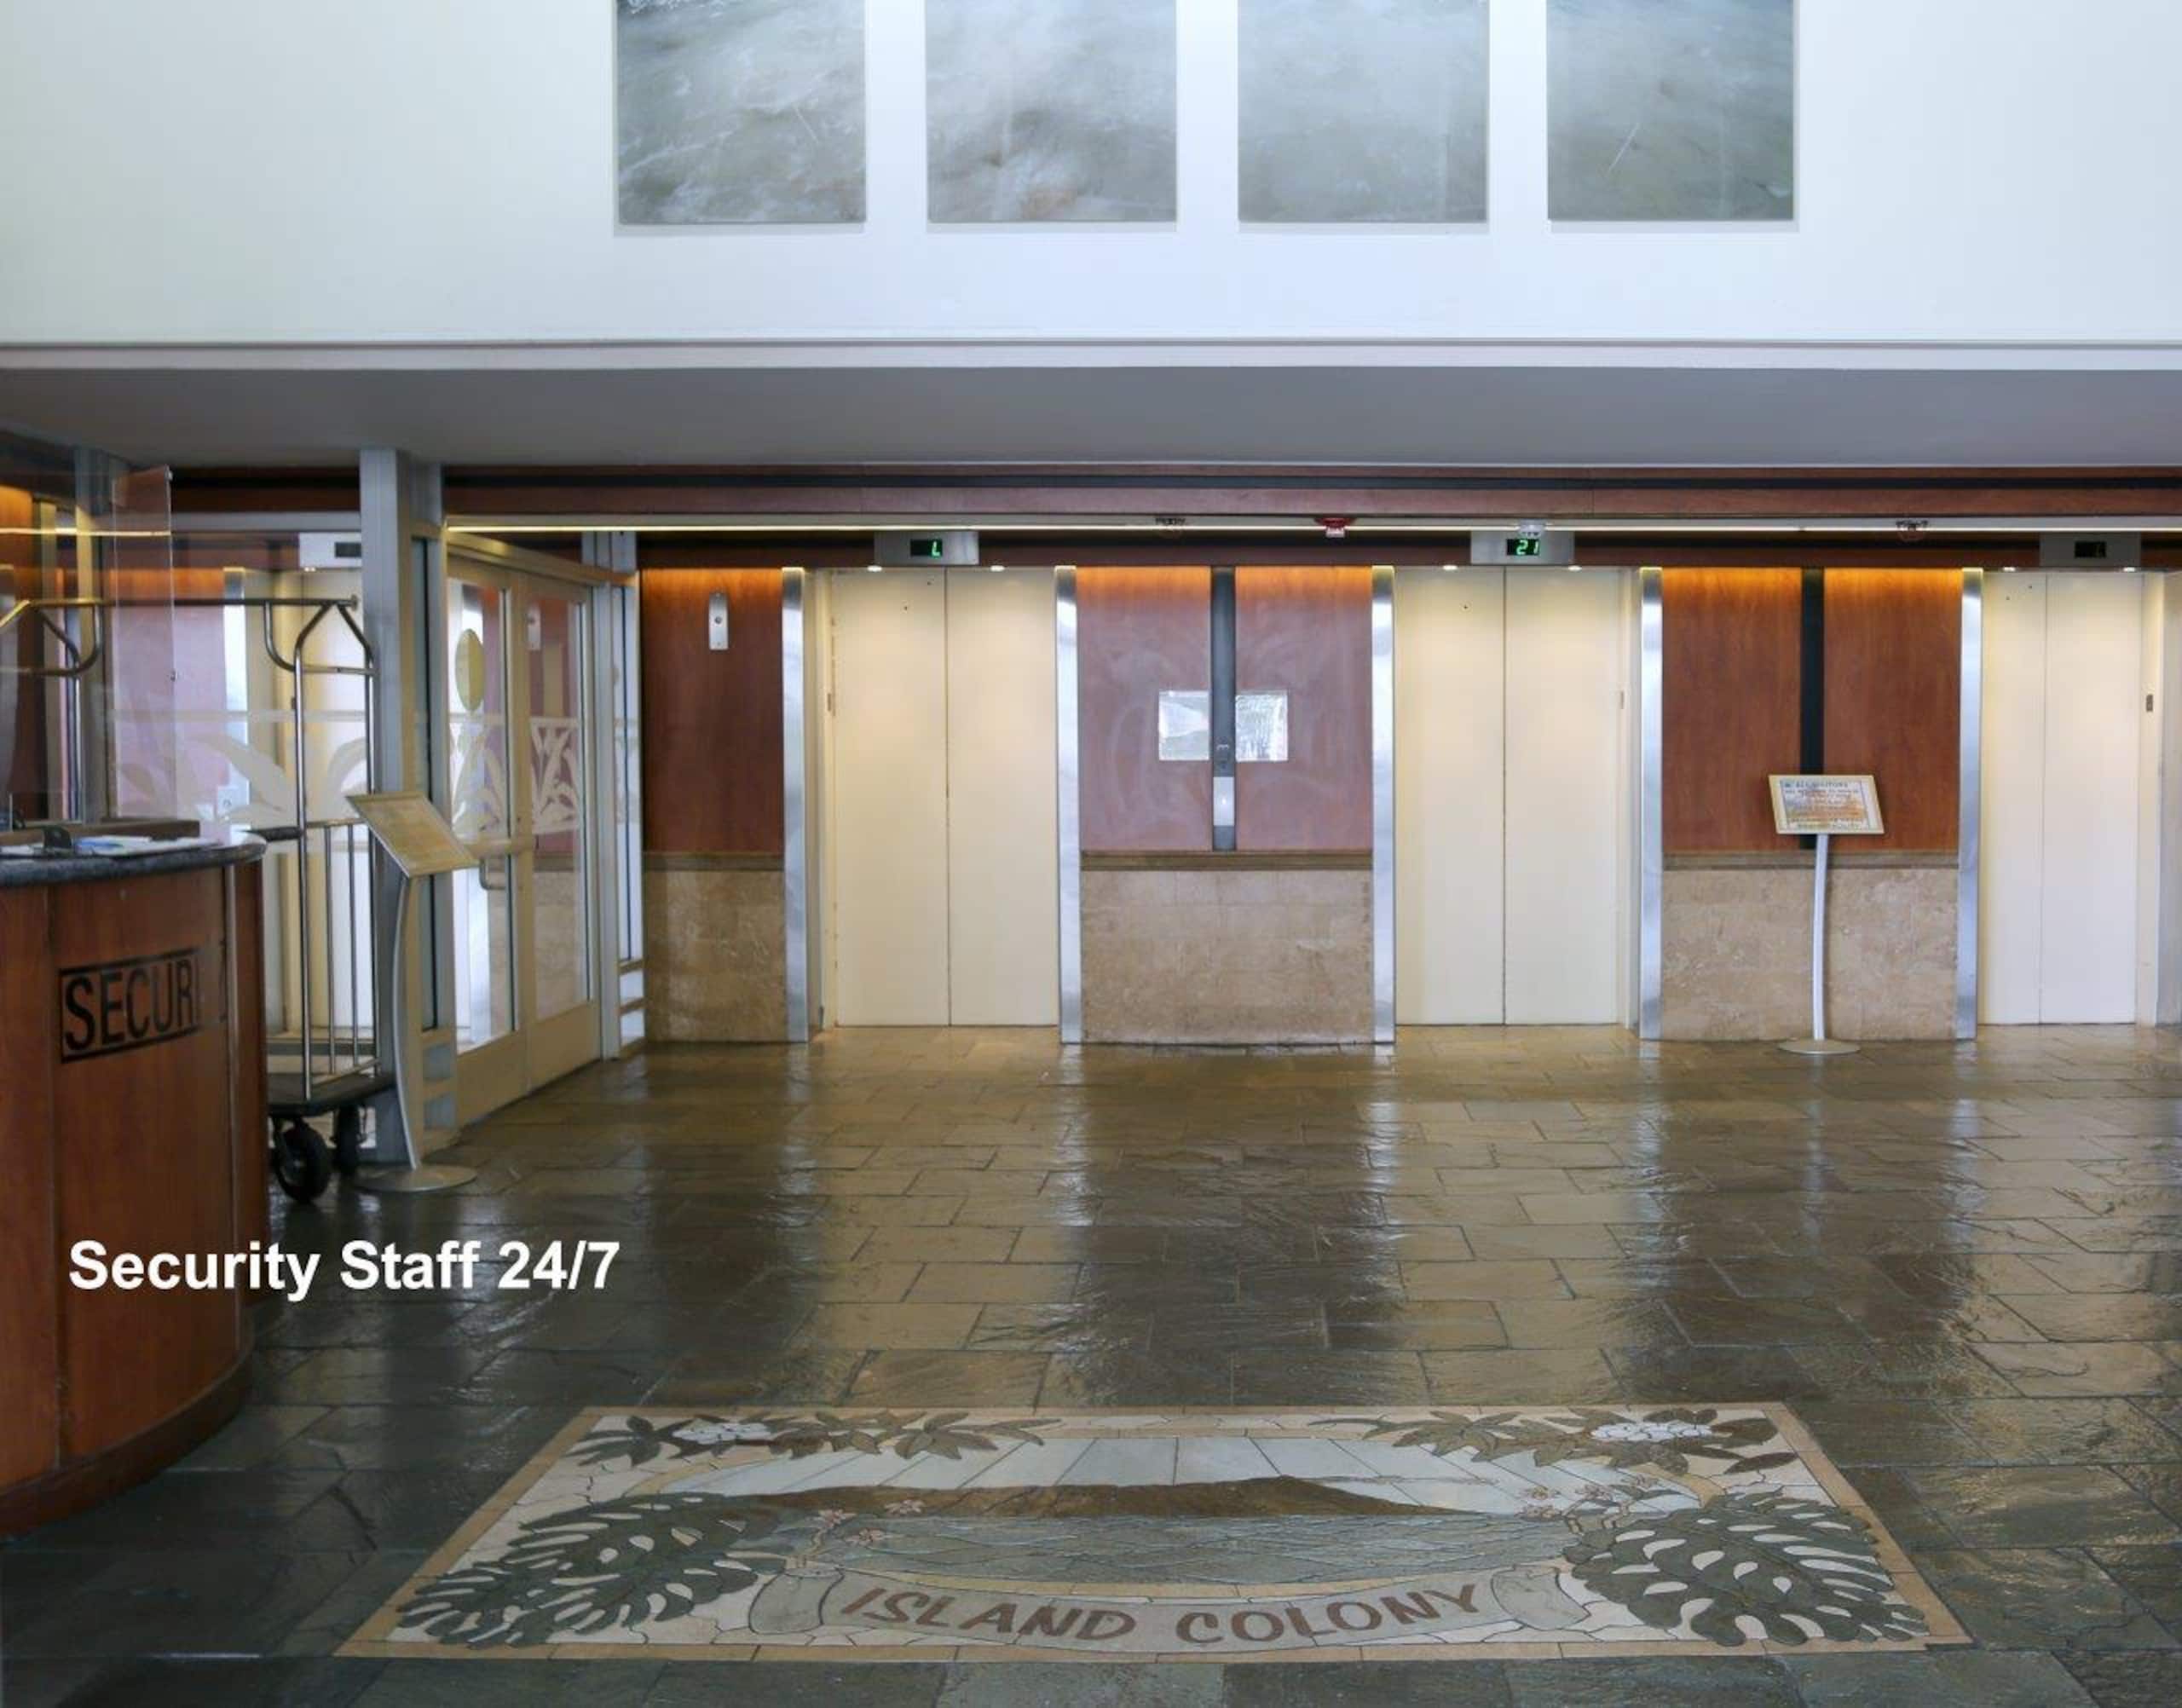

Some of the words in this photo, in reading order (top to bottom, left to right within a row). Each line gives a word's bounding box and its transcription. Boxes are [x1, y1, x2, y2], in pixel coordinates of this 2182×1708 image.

[931, 540, 941, 557] L
[1515, 539, 1539, 556] 21
[840, 1587, 1137, 1641] ISLAND
[1175, 1584, 1480, 1644] COLONY
